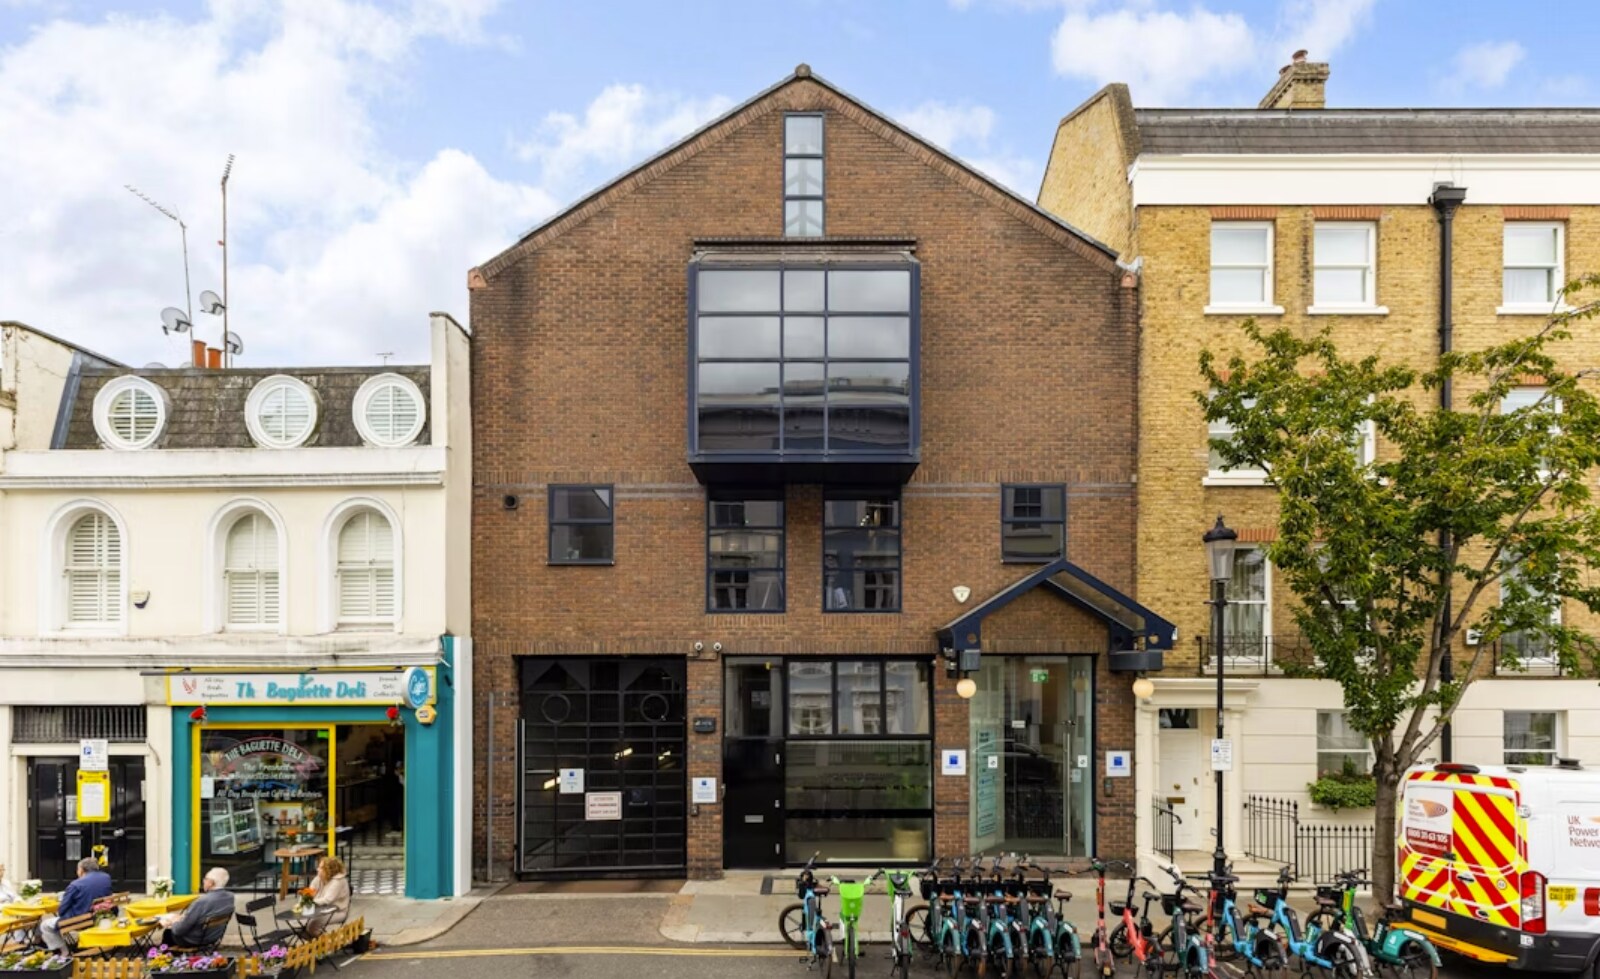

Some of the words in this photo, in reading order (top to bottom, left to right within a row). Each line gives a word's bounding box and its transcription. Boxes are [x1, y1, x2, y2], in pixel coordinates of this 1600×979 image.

[266, 680, 332, 702] Baguette
[336, 681, 366, 698] Deli
[225, 749, 240, 761] THE
[240, 740, 281, 755] BAGUETTE
[281, 742, 303, 760] DELI
[1567, 815, 1581, 825] UK
[1568, 826, 1599, 837] Power
